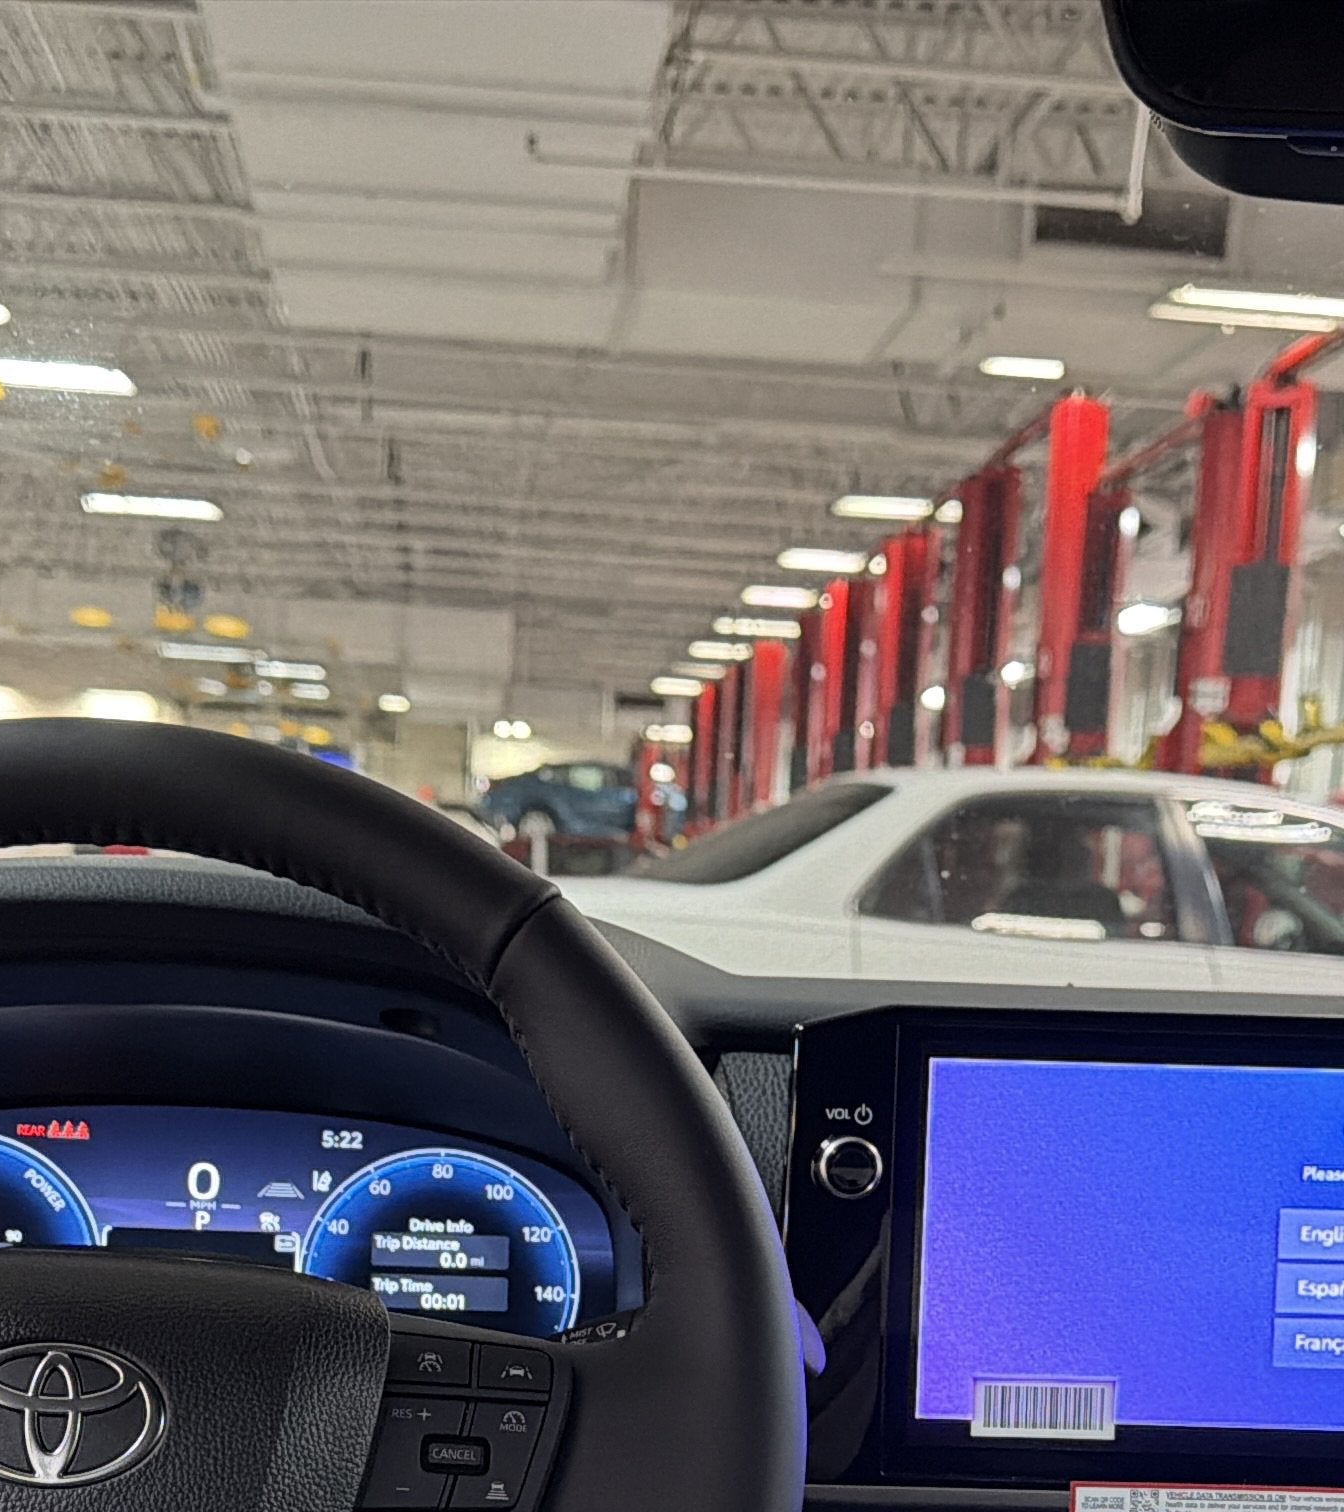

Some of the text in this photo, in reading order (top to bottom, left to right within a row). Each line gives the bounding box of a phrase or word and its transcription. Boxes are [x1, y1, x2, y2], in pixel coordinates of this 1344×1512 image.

[825, 1107, 851, 1120] VOL
[17, 1123, 45, 1138] REAR
[321, 1129, 363, 1150] 5:22
[431, 1163, 454, 1179] 80
[187, 1162, 220, 1200] 0
[368, 1179, 391, 1196] 60
[23, 1168, 66, 1212] POWER
[485, 1184, 514, 1201] 100
[189, 1200, 217, 1210] MPH
[195, 1210, 211, 1231] P
[327, 1218, 350, 1236] 40
[409, 1217, 474, 1234] Drive Info
[522, 1226, 552, 1243] 120
[374, 1235, 460, 1252] Trip Distance
[439, 1252, 484, 1269] 0.0 mi
[372, 1277, 433, 1294] Trip Time
[534, 1285, 564, 1302] 140
[420, 1294, 466, 1310] 00:01
[569, 1327, 594, 1338] MIST
[391, 1408, 413, 1419] RES
[499, 1421, 527, 1433] MODE
[432, 1447, 477, 1461] CANCEL
